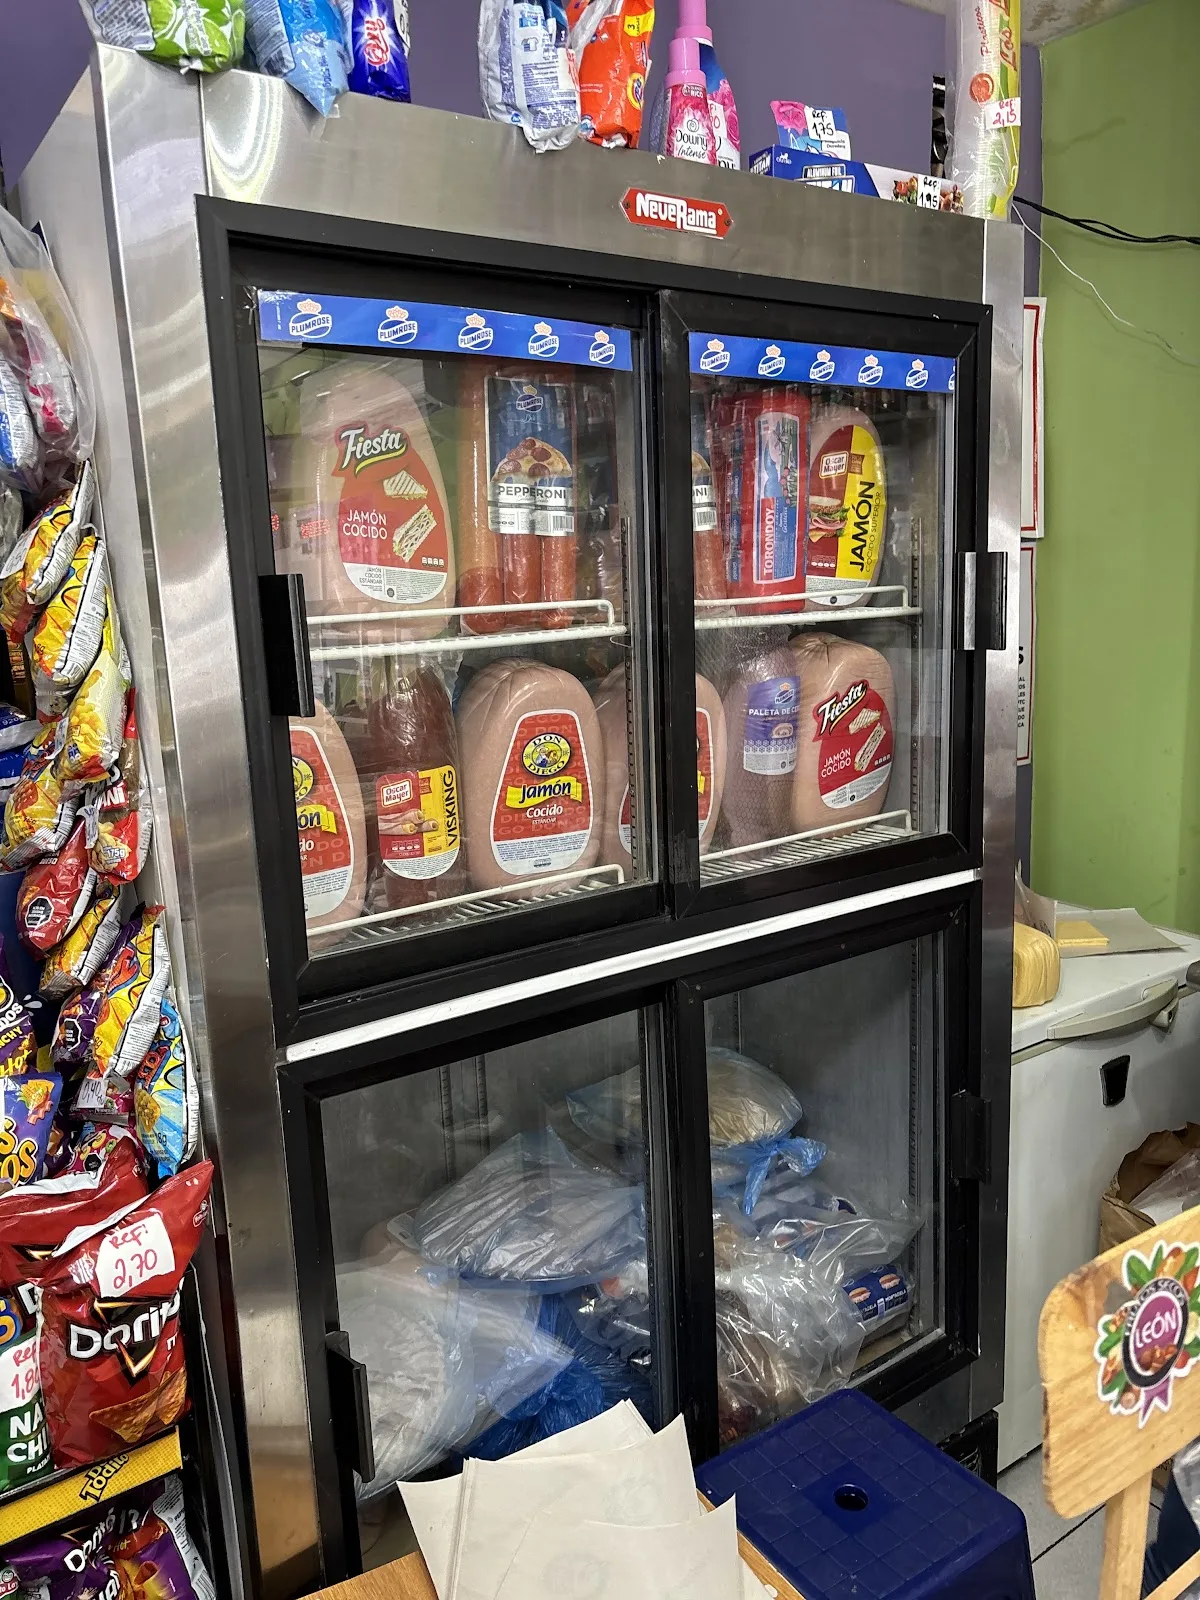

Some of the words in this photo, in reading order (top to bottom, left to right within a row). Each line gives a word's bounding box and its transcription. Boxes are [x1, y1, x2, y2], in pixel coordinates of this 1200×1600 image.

[993, 109, 1017, 126] 2,15
[811, 122, 834, 139] 1,75
[675, 129, 708, 152] Downy
[677, 145, 706, 159] Intense
[291, 315, 331, 335] PLUMROSE
[379, 321, 417, 340] PLUMROSE
[459, 328, 493, 347] PLUMROSE
[528, 336, 559, 354] PLUMROSE
[590, 345, 615, 361] PLUMROSE
[701, 352, 730, 368] PLUMROSE
[758, 357, 785, 373] PLUMROSE
[810, 362, 835, 377] PLUMROSE
[858, 367, 883, 382] PLUMROSE
[906, 371, 928, 386] PLUMROSE
[516, 398, 543, 410] PLUMROSE
[340, 428, 403, 469] Fiesta
[823, 464, 845, 474] Mayer
[825, 455, 845, 466] Oscar
[498, 485, 567, 500] PEPPERONI
[346, 509, 387, 526] JAMÓN
[342, 522, 389, 540] COCIDO
[849, 481, 876, 573] JAMÓN
[864, 534, 877, 573] COCIDO
[871, 491, 883, 533] SUPERIOR
[763, 507, 775, 576] TORONDOY
[748, 707, 780, 717] PALETA
[817, 683, 863, 735] Fiesta
[532, 734, 562, 747] DON
[823, 747, 852, 769] JAMÓN
[527, 760, 566, 775] DIEGO
[820, 757, 852, 779] COCIDO
[385, 783, 409, 796] Oscar
[385, 790, 409, 803] Mayer
[518, 779, 572, 805] Jamón
[443, 770, 459, 848] VISKING
[526, 804, 564, 819] Cocido
[107, 847, 126, 858] 175g
[113, 1248, 158, 1290] 2,70
[1135, 1307, 1178, 1349] LEÓN
